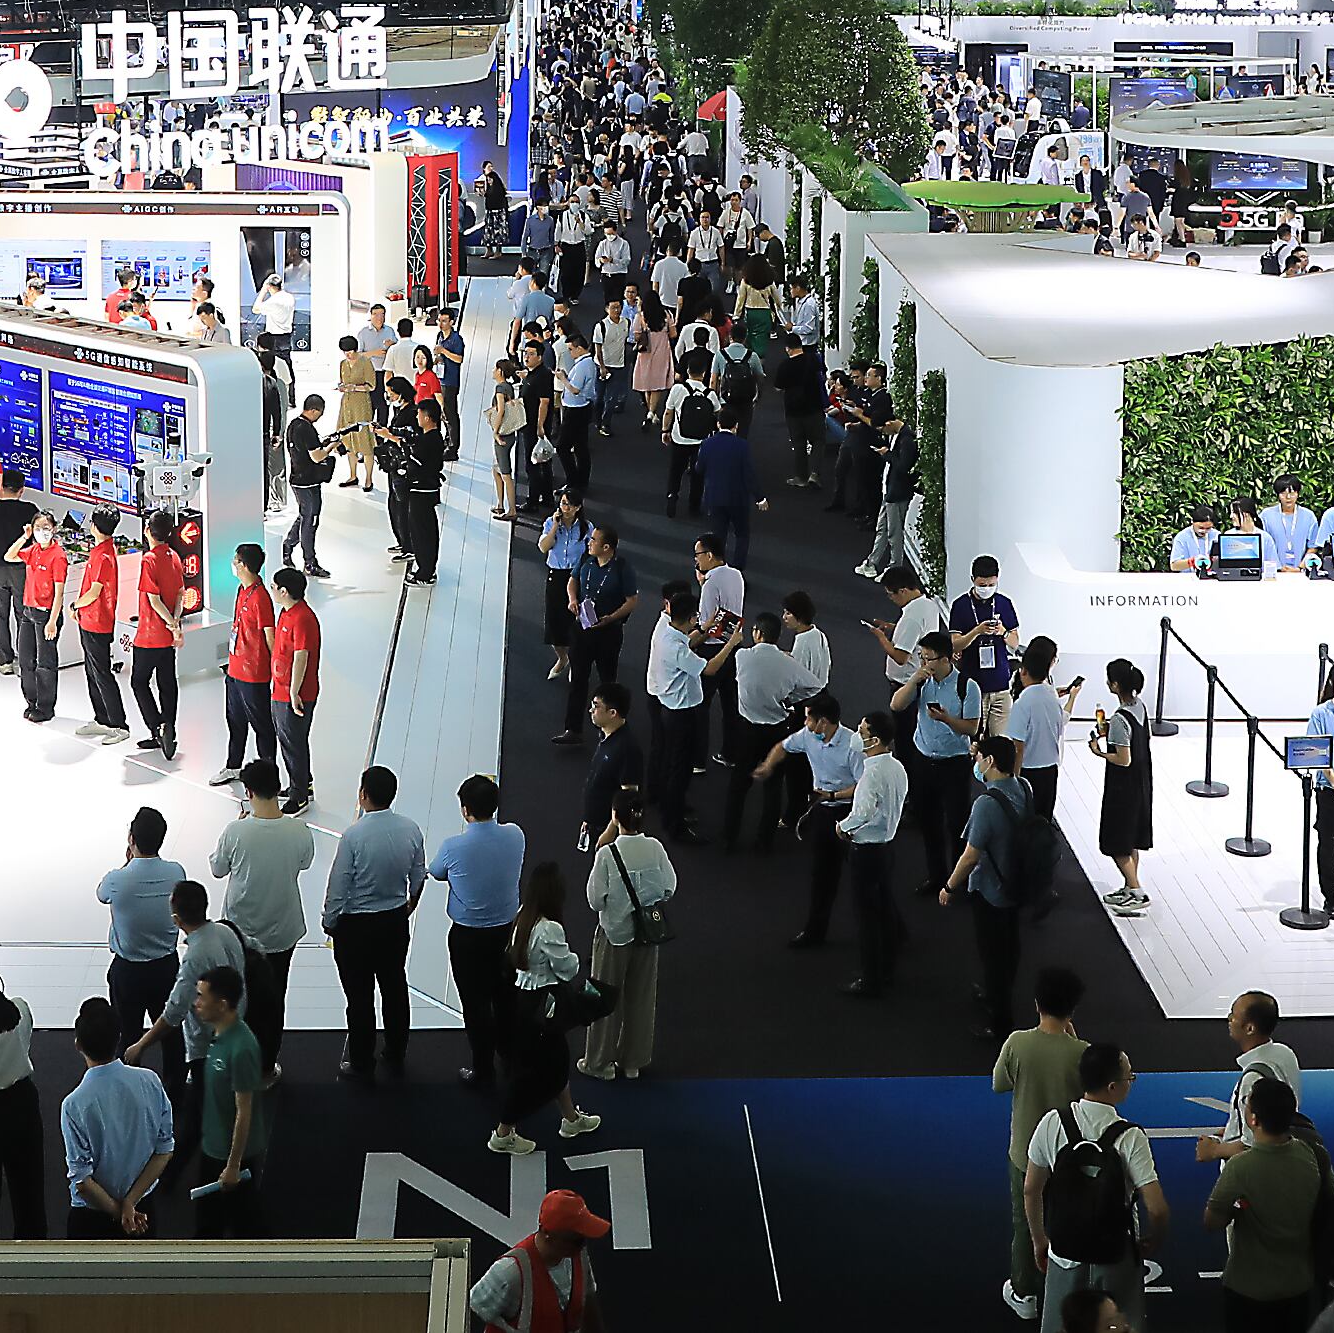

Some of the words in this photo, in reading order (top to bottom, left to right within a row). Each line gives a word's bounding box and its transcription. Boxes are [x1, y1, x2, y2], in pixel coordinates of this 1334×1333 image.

[81, 5, 388, 104] 中国联通
[269, 205, 300, 214] AR互动
[1089, 595, 1198, 606] INFORMATION
[356, 1148, 652, 1250] N1
